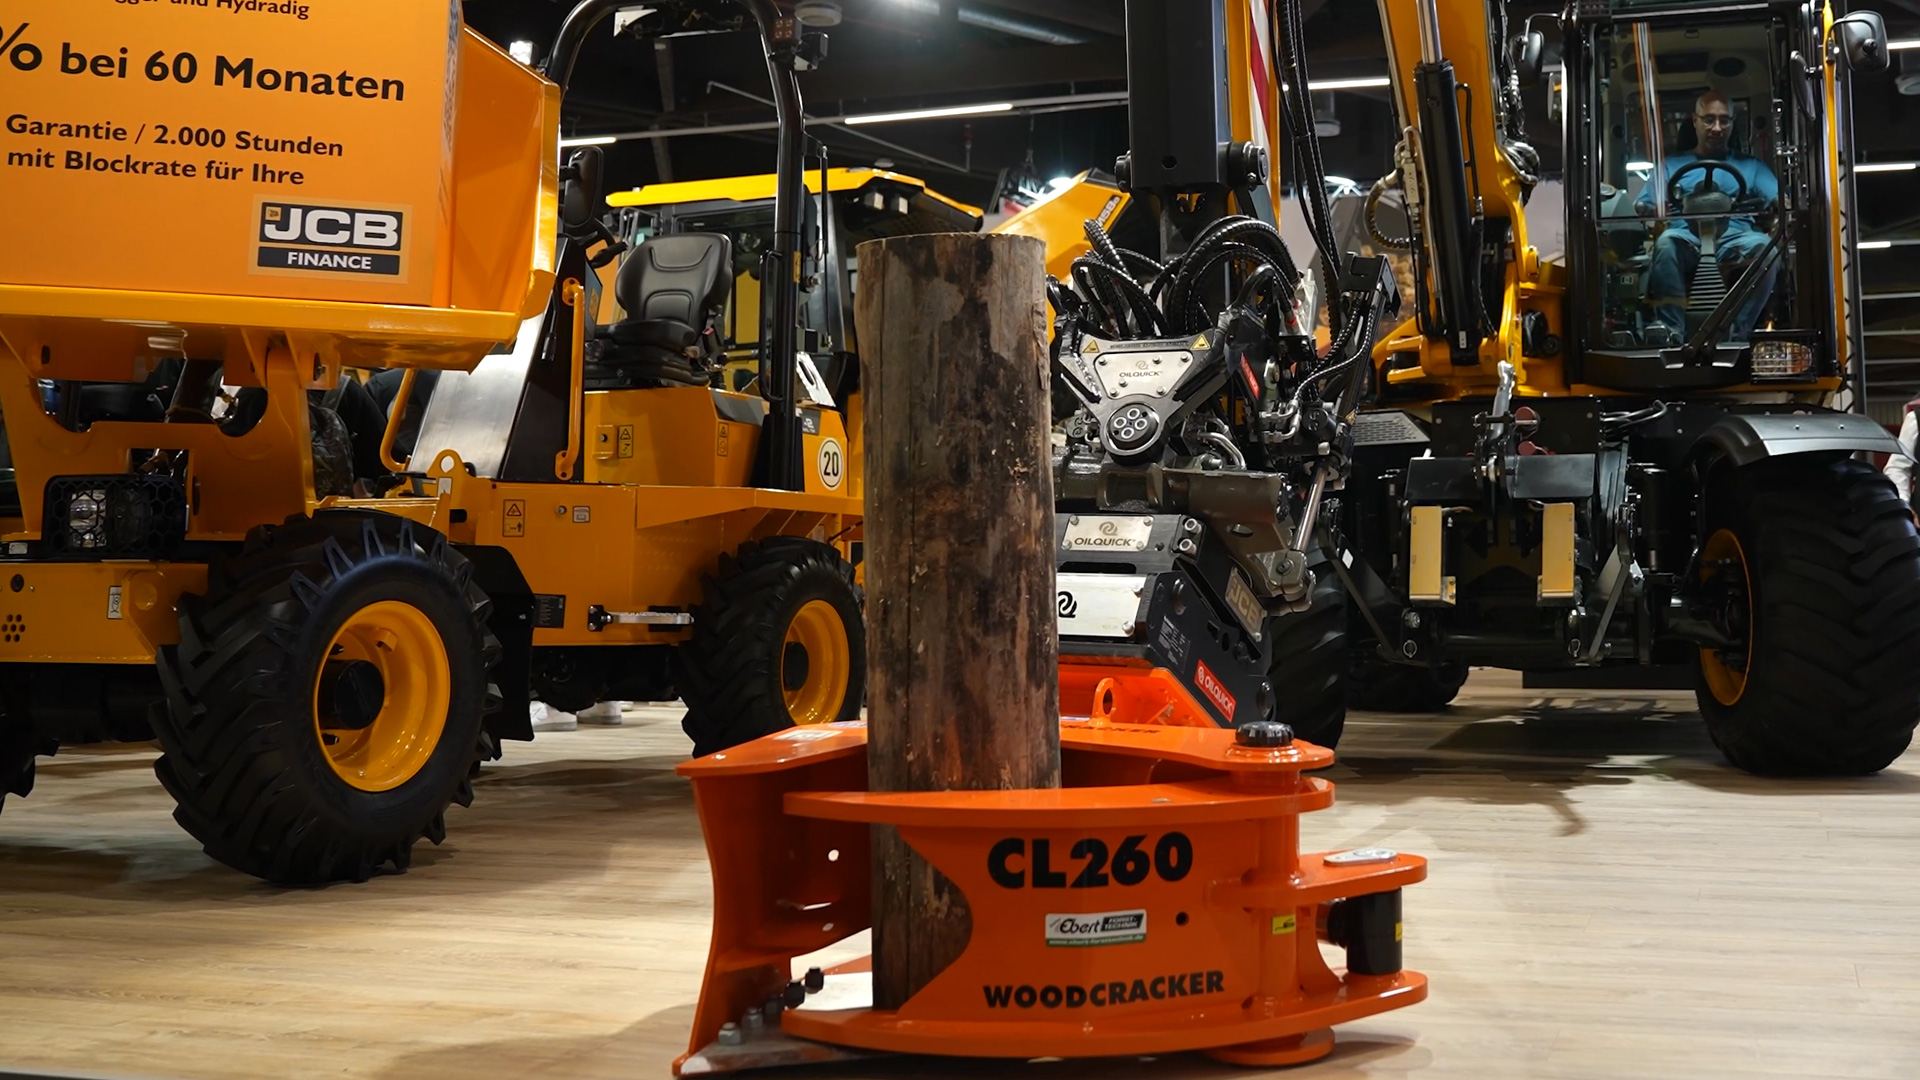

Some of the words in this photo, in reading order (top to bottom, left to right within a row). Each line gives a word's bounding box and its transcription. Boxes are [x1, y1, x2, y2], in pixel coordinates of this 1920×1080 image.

[216, 0, 310, 20] Hydradig
[60, 42, 128, 78] bei
[144, 50, 198, 84] 60
[214, 55, 405, 101] Monaten
[5, 114, 128, 141] Garantie
[134, 123, 146, 145] /
[153, 124, 226, 148] 2.000
[235, 130, 343, 157] Stunden
[7, 148, 55, 169] mit
[64, 150, 197, 178] Blockrate
[205, 160, 244, 181] für
[252, 163, 305, 185] Ihre
[264, 208, 399, 247] JCB
[287, 252, 372, 270] FINANCE
[823, 451, 839, 477] 20
[1074, 537, 1131, 546] OILQUICK
[1228, 582, 1262, 631] JCB
[1205, 675, 1233, 714] OILQUICK
[987, 831, 1193, 890] CL260
[1060, 917, 1100, 934] Ebert
[983, 970, 1225, 1009] WOODCRACKER
